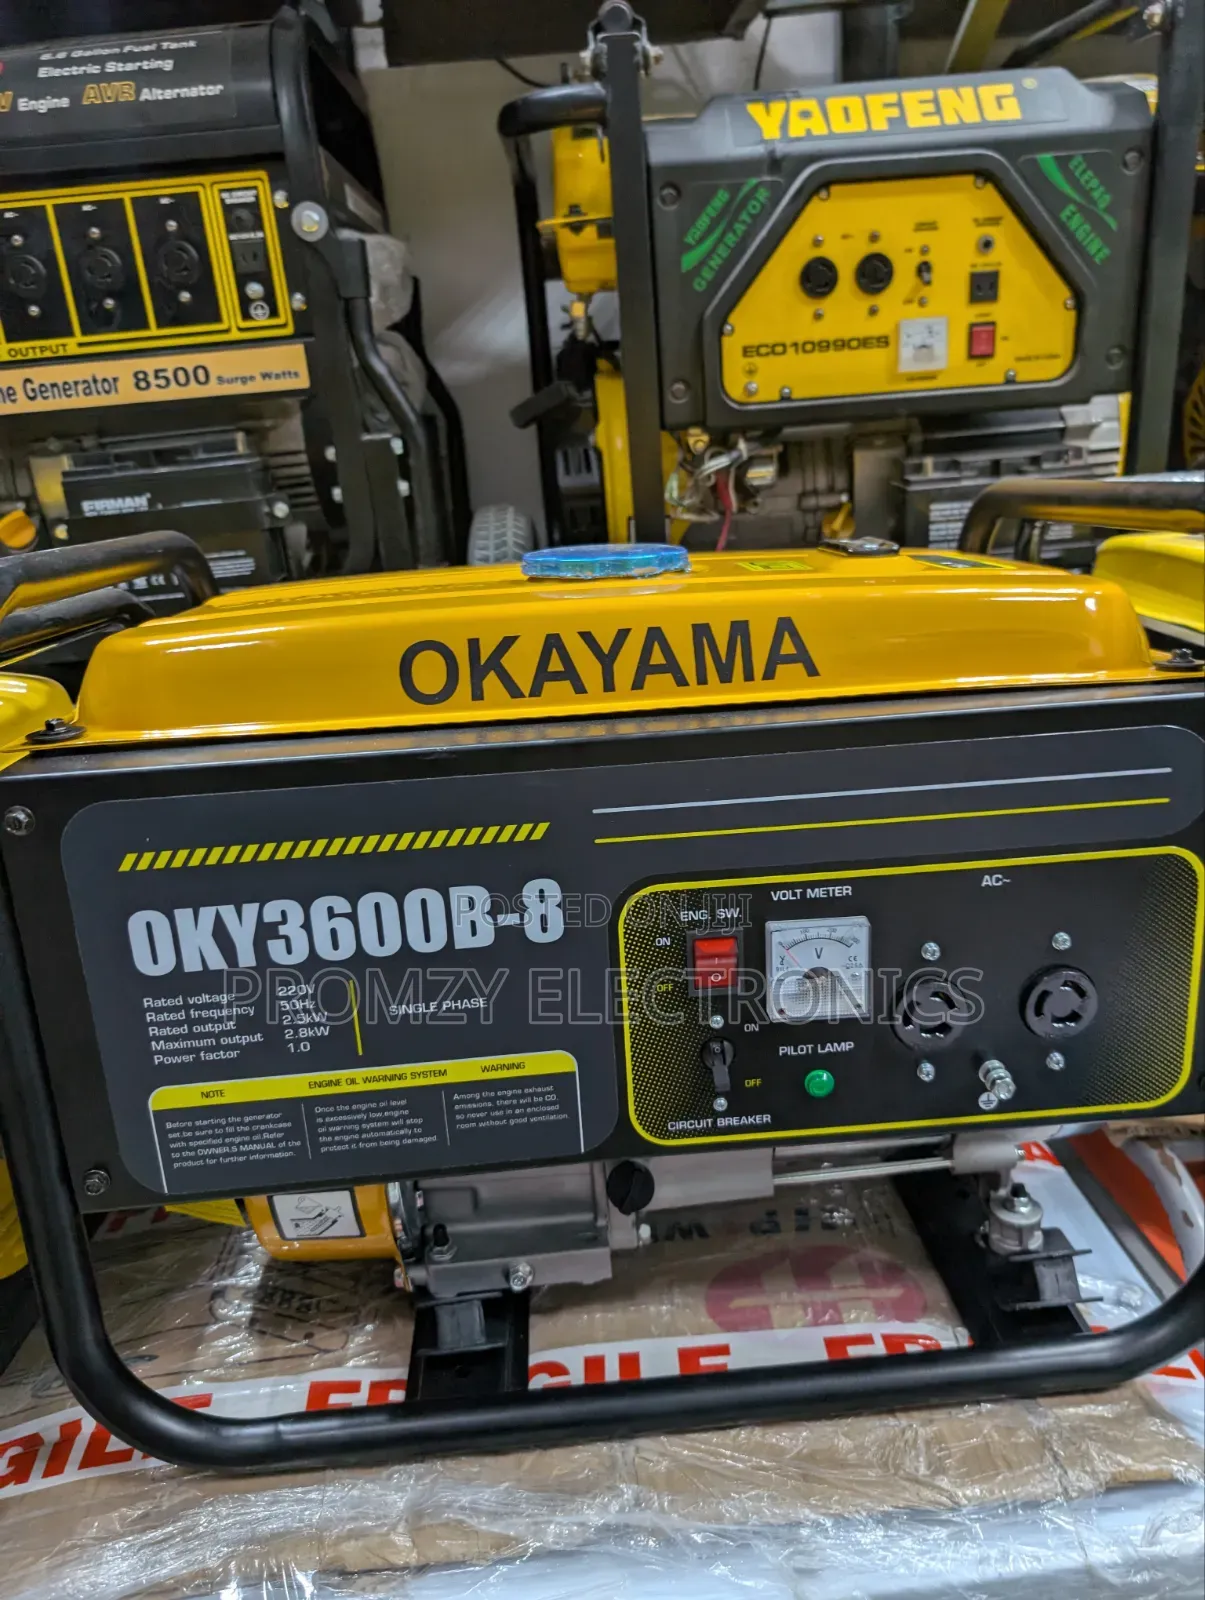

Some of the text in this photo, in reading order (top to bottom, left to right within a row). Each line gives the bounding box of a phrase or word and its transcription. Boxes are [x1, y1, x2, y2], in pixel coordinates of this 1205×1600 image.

[122, 43, 157, 53] Fuel
[161, 40, 197, 50] Tank
[37, 58, 174, 78] Electric Starting
[17, 96, 70, 113] Engine
[82, 81, 136, 105] AVR
[139, 84, 224, 101] Alternator
[746, 83, 1022, 140] YAOFENG
[692, 186, 771, 292] GENERATOR
[1059, 203, 1111, 266] ENGINE
[8, 343, 68, 358] OUTPUT
[22, 374, 119, 401] Generator
[133, 365, 210, 391] 8500
[216, 375, 256, 386] Surge
[260, 370, 300, 380] Watts
[81, 496, 148, 512] FIRMAN
[399, 616, 820, 706] OKAYAMA
[771, 886, 852, 901] VOLT METER
[680, 907, 742, 921] ENG. SW.
[127, 878, 564, 976] OKY3600B-8
[655, 937, 671, 946] ON
[814, 947, 823, 959] V
[656, 983, 674, 992] OFF
[143, 984, 316, 1008] Rated voltage 220V
[146, 999, 316, 1022] Rated frequency 50Hz
[389, 997, 488, 1016] SINGLE PHASE
[148, 1023, 188, 1037] Rated
[192, 1020, 236, 1034] output
[744, 1023, 760, 1032] ON
[151, 1025, 330, 1051] Maximum output 2.8kW
[153, 1041, 311, 1065] Power factor 1.0
[779, 1041, 854, 1056] PILOT LAMP
[481, 1061, 526, 1073] WARNING
[308, 1068, 447, 1089] ENGINE OIL WARNING SYSTEM
[744, 1078, 762, 1088] OFF
[201, 1088, 226, 1099] NOTE
[453, 1092, 480, 1101] Among
[497, 1088, 522, 1097] engine
[524, 1085, 554, 1094] exhaust
[315, 1106, 334, 1114] Once
[352, 1102, 377, 1111] engine
[390, 1099, 407, 1107] level
[497, 1099, 517, 1107] there
[326, 1112, 367, 1124] excessively
[467, 1111, 488, 1119] never
[527, 1104, 560, 1113] enclosed
[166, 1121, 193, 1130] Before
[195, 1117, 226, 1127] starting
[243, 1112, 282, 1122] generator
[226, 1126, 235, 1134] fill
[252, 1121, 292, 1131] crankcase
[329, 1123, 360, 1132] warning
[362, 1121, 389, 1131] system
[391, 1119, 404, 1127] will
[406, 1117, 423, 1126] stop
[457, 1122, 477, 1130] room
[479, 1118, 508, 1128] without
[509, 1117, 528, 1126] good
[667, 1114, 772, 1131] CIRCUIT BREAKER
[169, 1140, 187, 1149] with
[189, 1137, 223, 1147] specified
[225, 1135, 250, 1144] engine
[335, 1133, 359, 1142] engine
[361, 1128, 412, 1139] automatically
[240, 1143, 276, 1153] MANUAL
[321, 1143, 352, 1154] protect
[359, 1141, 378, 1149] from
[380, 1138, 401, 1147] being
[403, 1134, 437, 1145] damaged
[174, 1159, 204, 1169] product
[220, 1154, 247, 1164] further
